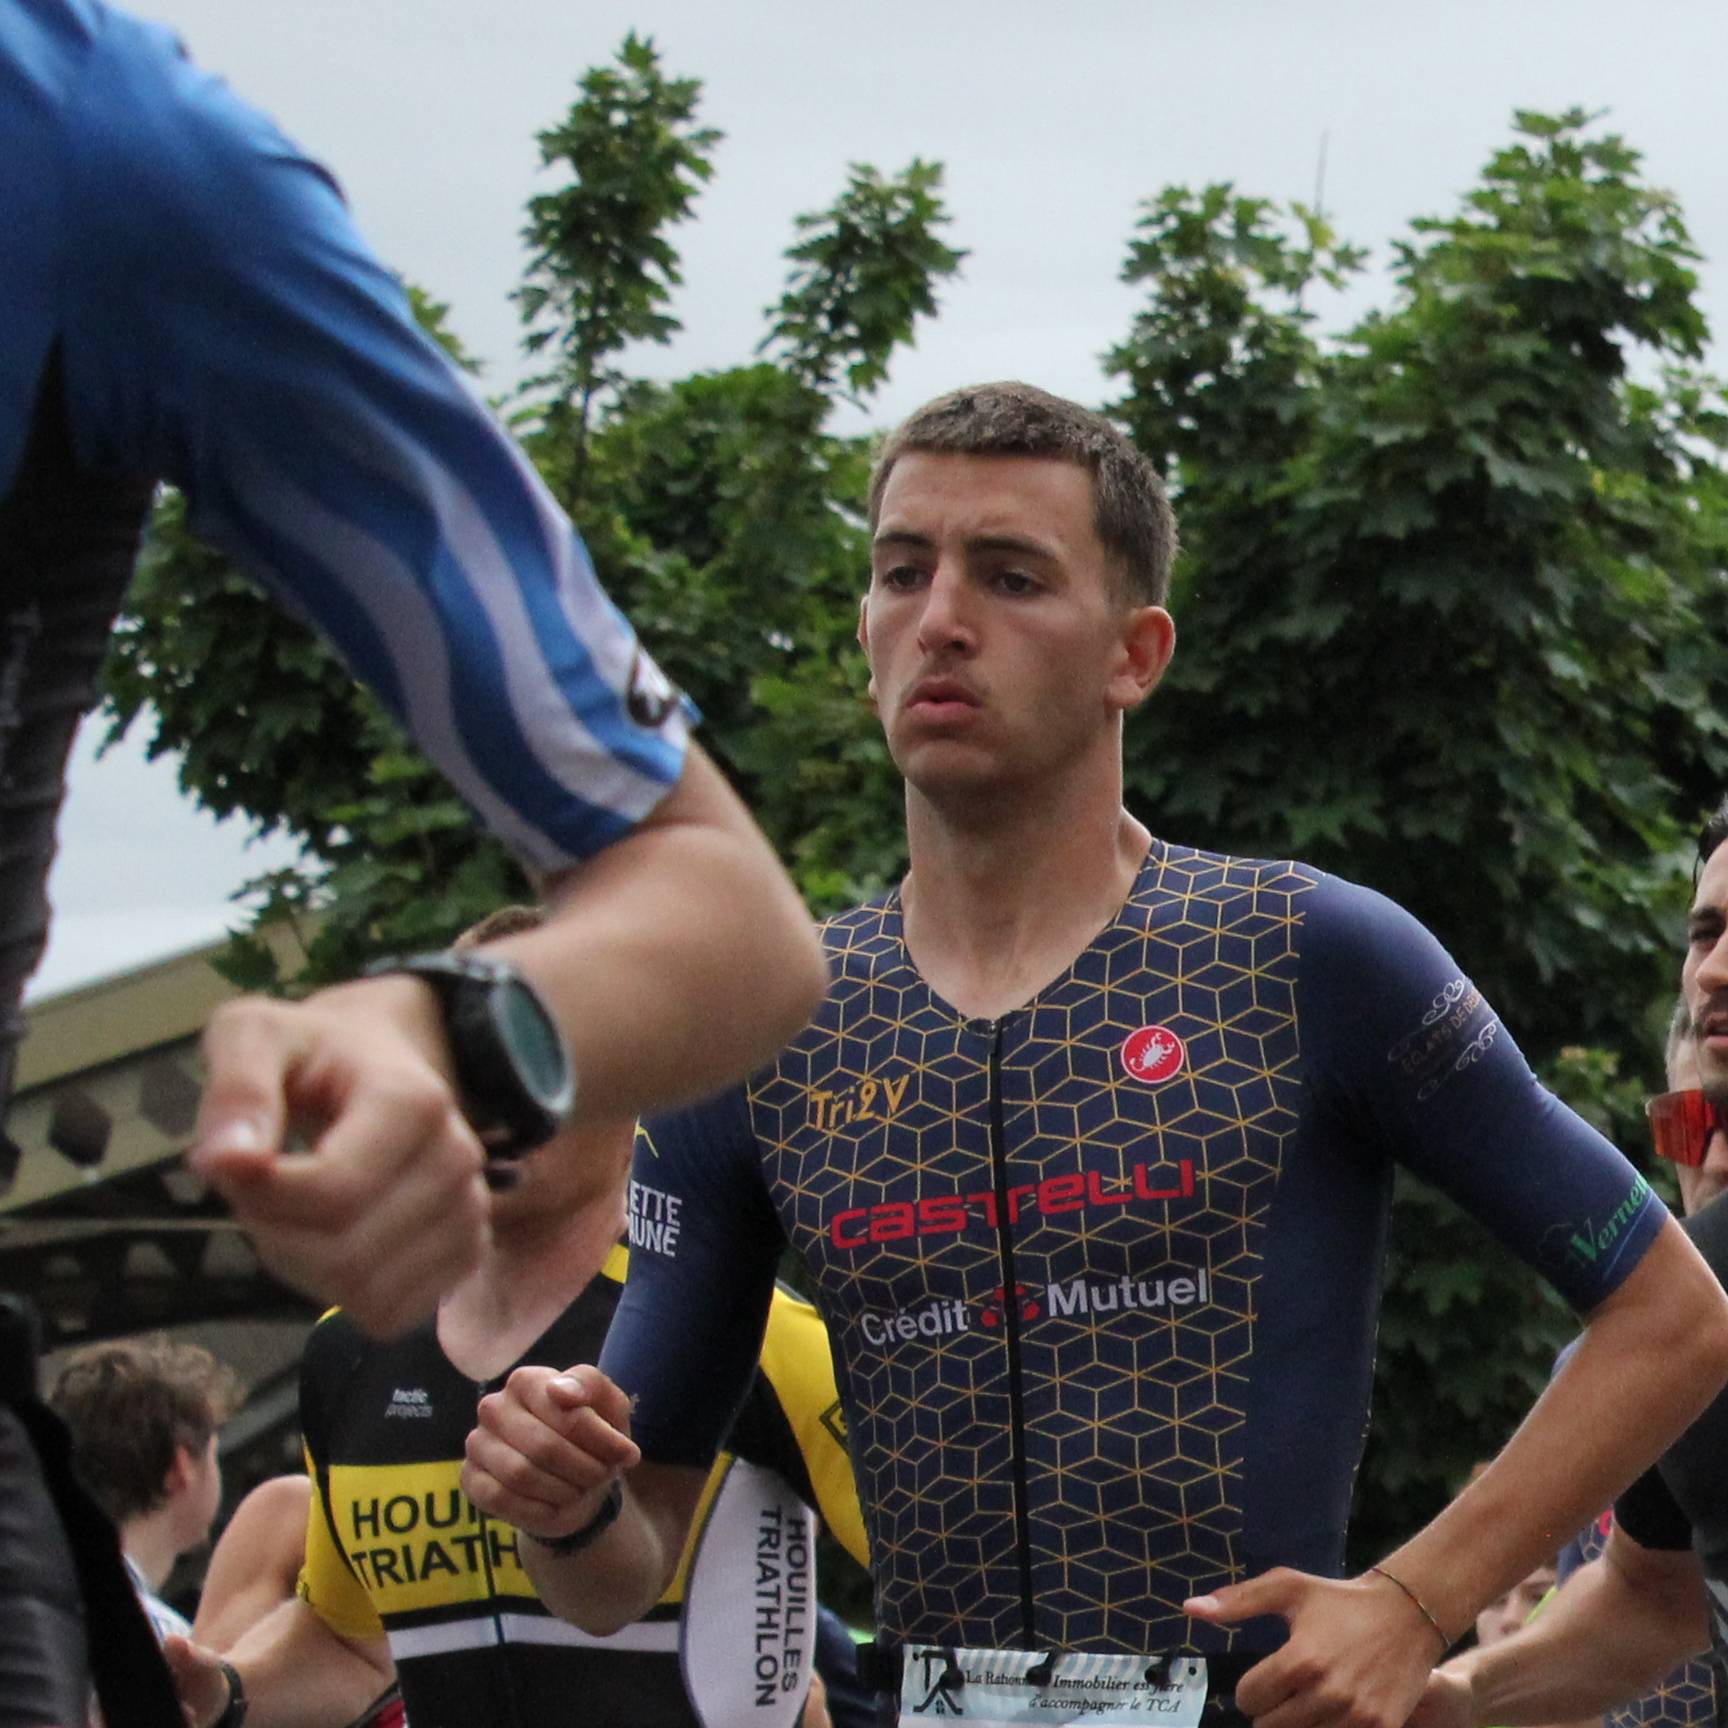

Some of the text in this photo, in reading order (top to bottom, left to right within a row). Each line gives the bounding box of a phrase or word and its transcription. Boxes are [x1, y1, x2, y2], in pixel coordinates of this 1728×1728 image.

[860, 1268, 1212, 1347] Crédit Mutuel
[755, 1505, 782, 1707] TRIATHLON
[781, 1513, 809, 1692] HOUILLES
[1053, 1674, 1131, 1691] Immobilier
[1148, 1699, 1182, 1714] TCA
